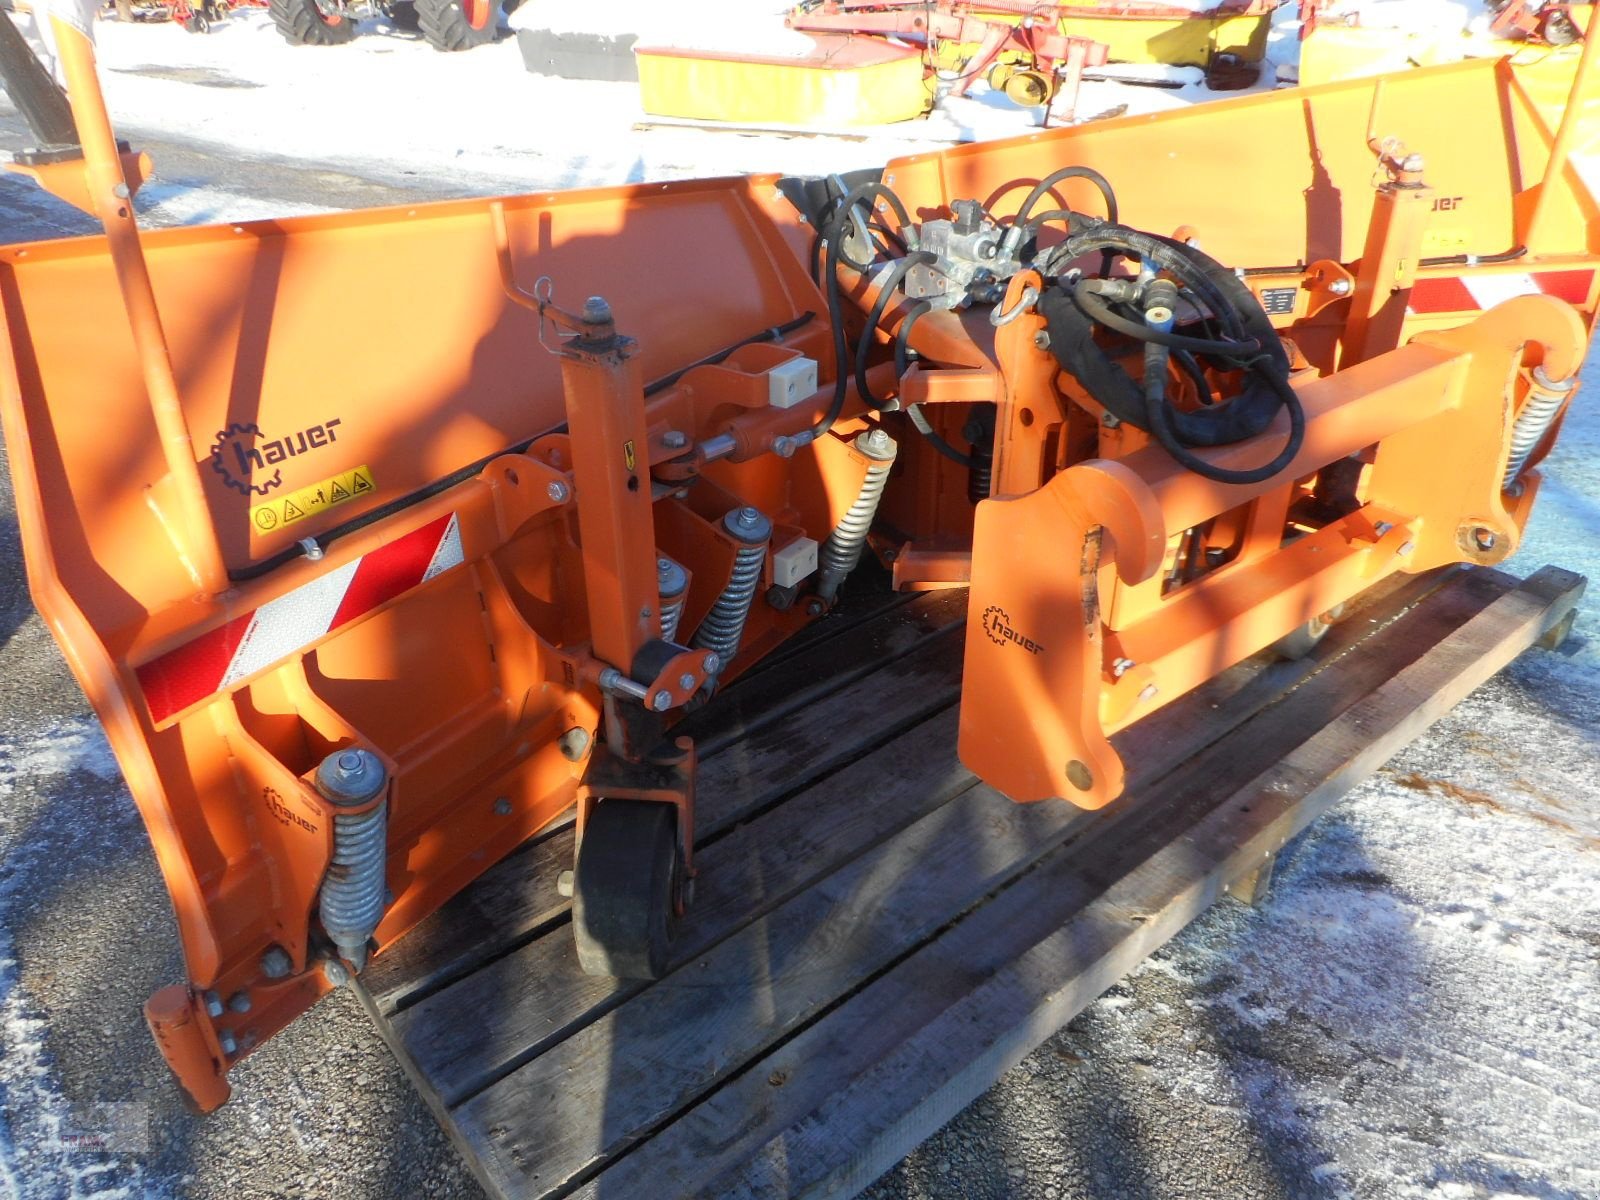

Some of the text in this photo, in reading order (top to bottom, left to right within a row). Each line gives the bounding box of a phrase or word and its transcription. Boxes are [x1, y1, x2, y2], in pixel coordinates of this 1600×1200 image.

[233, 418, 341, 475] hauer
[991, 614, 1045, 655] hauer
[271, 795, 318, 835] hauer
